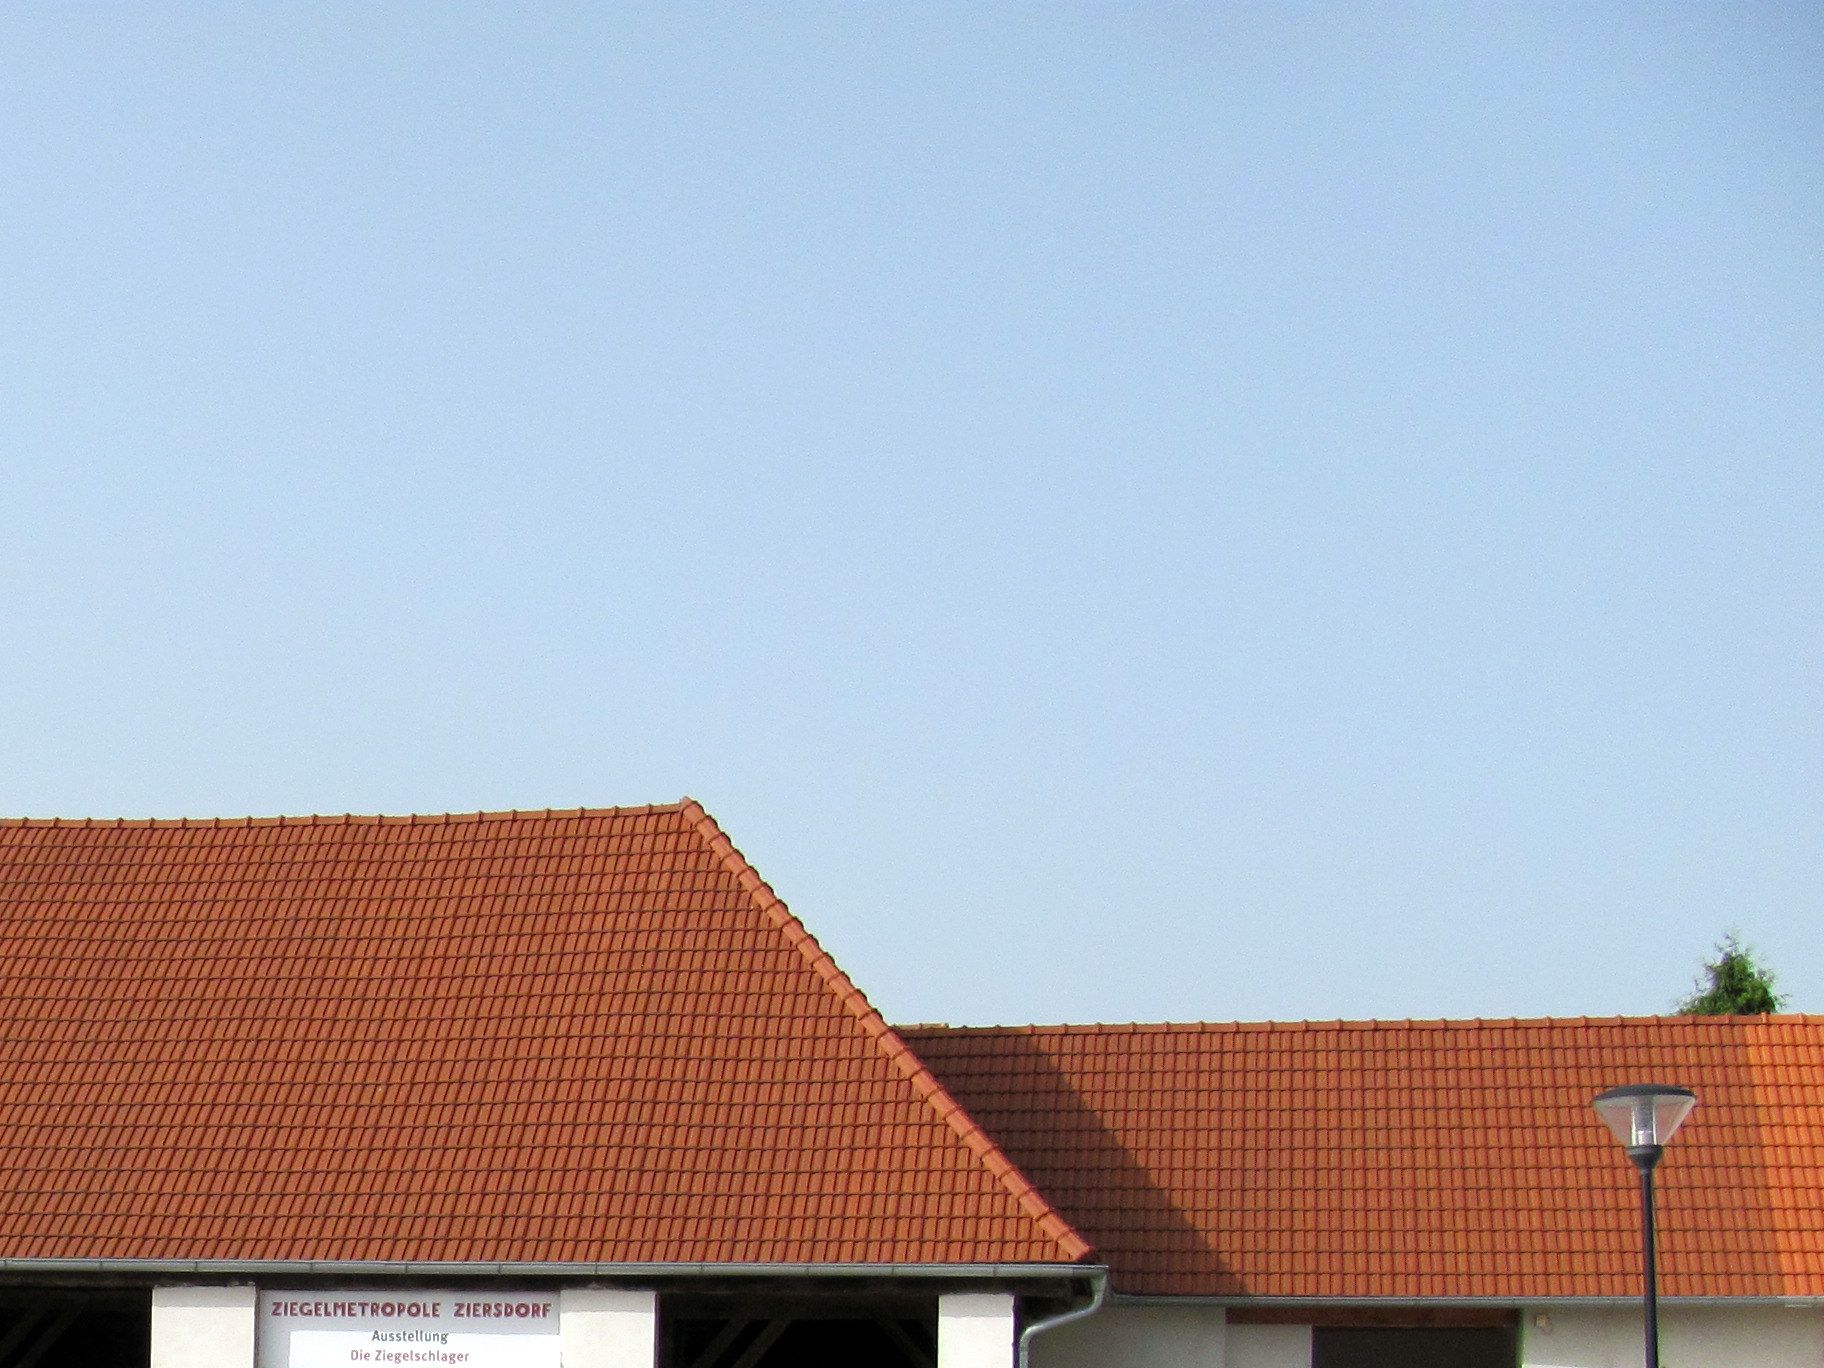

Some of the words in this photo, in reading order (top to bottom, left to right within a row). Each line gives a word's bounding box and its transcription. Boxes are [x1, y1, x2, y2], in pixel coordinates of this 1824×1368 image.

[271, 1301, 440, 1318] ZIEGELMETROPOLE
[453, 1301, 551, 1319] ZIERSDORF
[372, 1330, 448, 1345] Ausstellung
[350, 1349, 370, 1362] Die
[375, 1349, 470, 1364] Ziegelschlager
